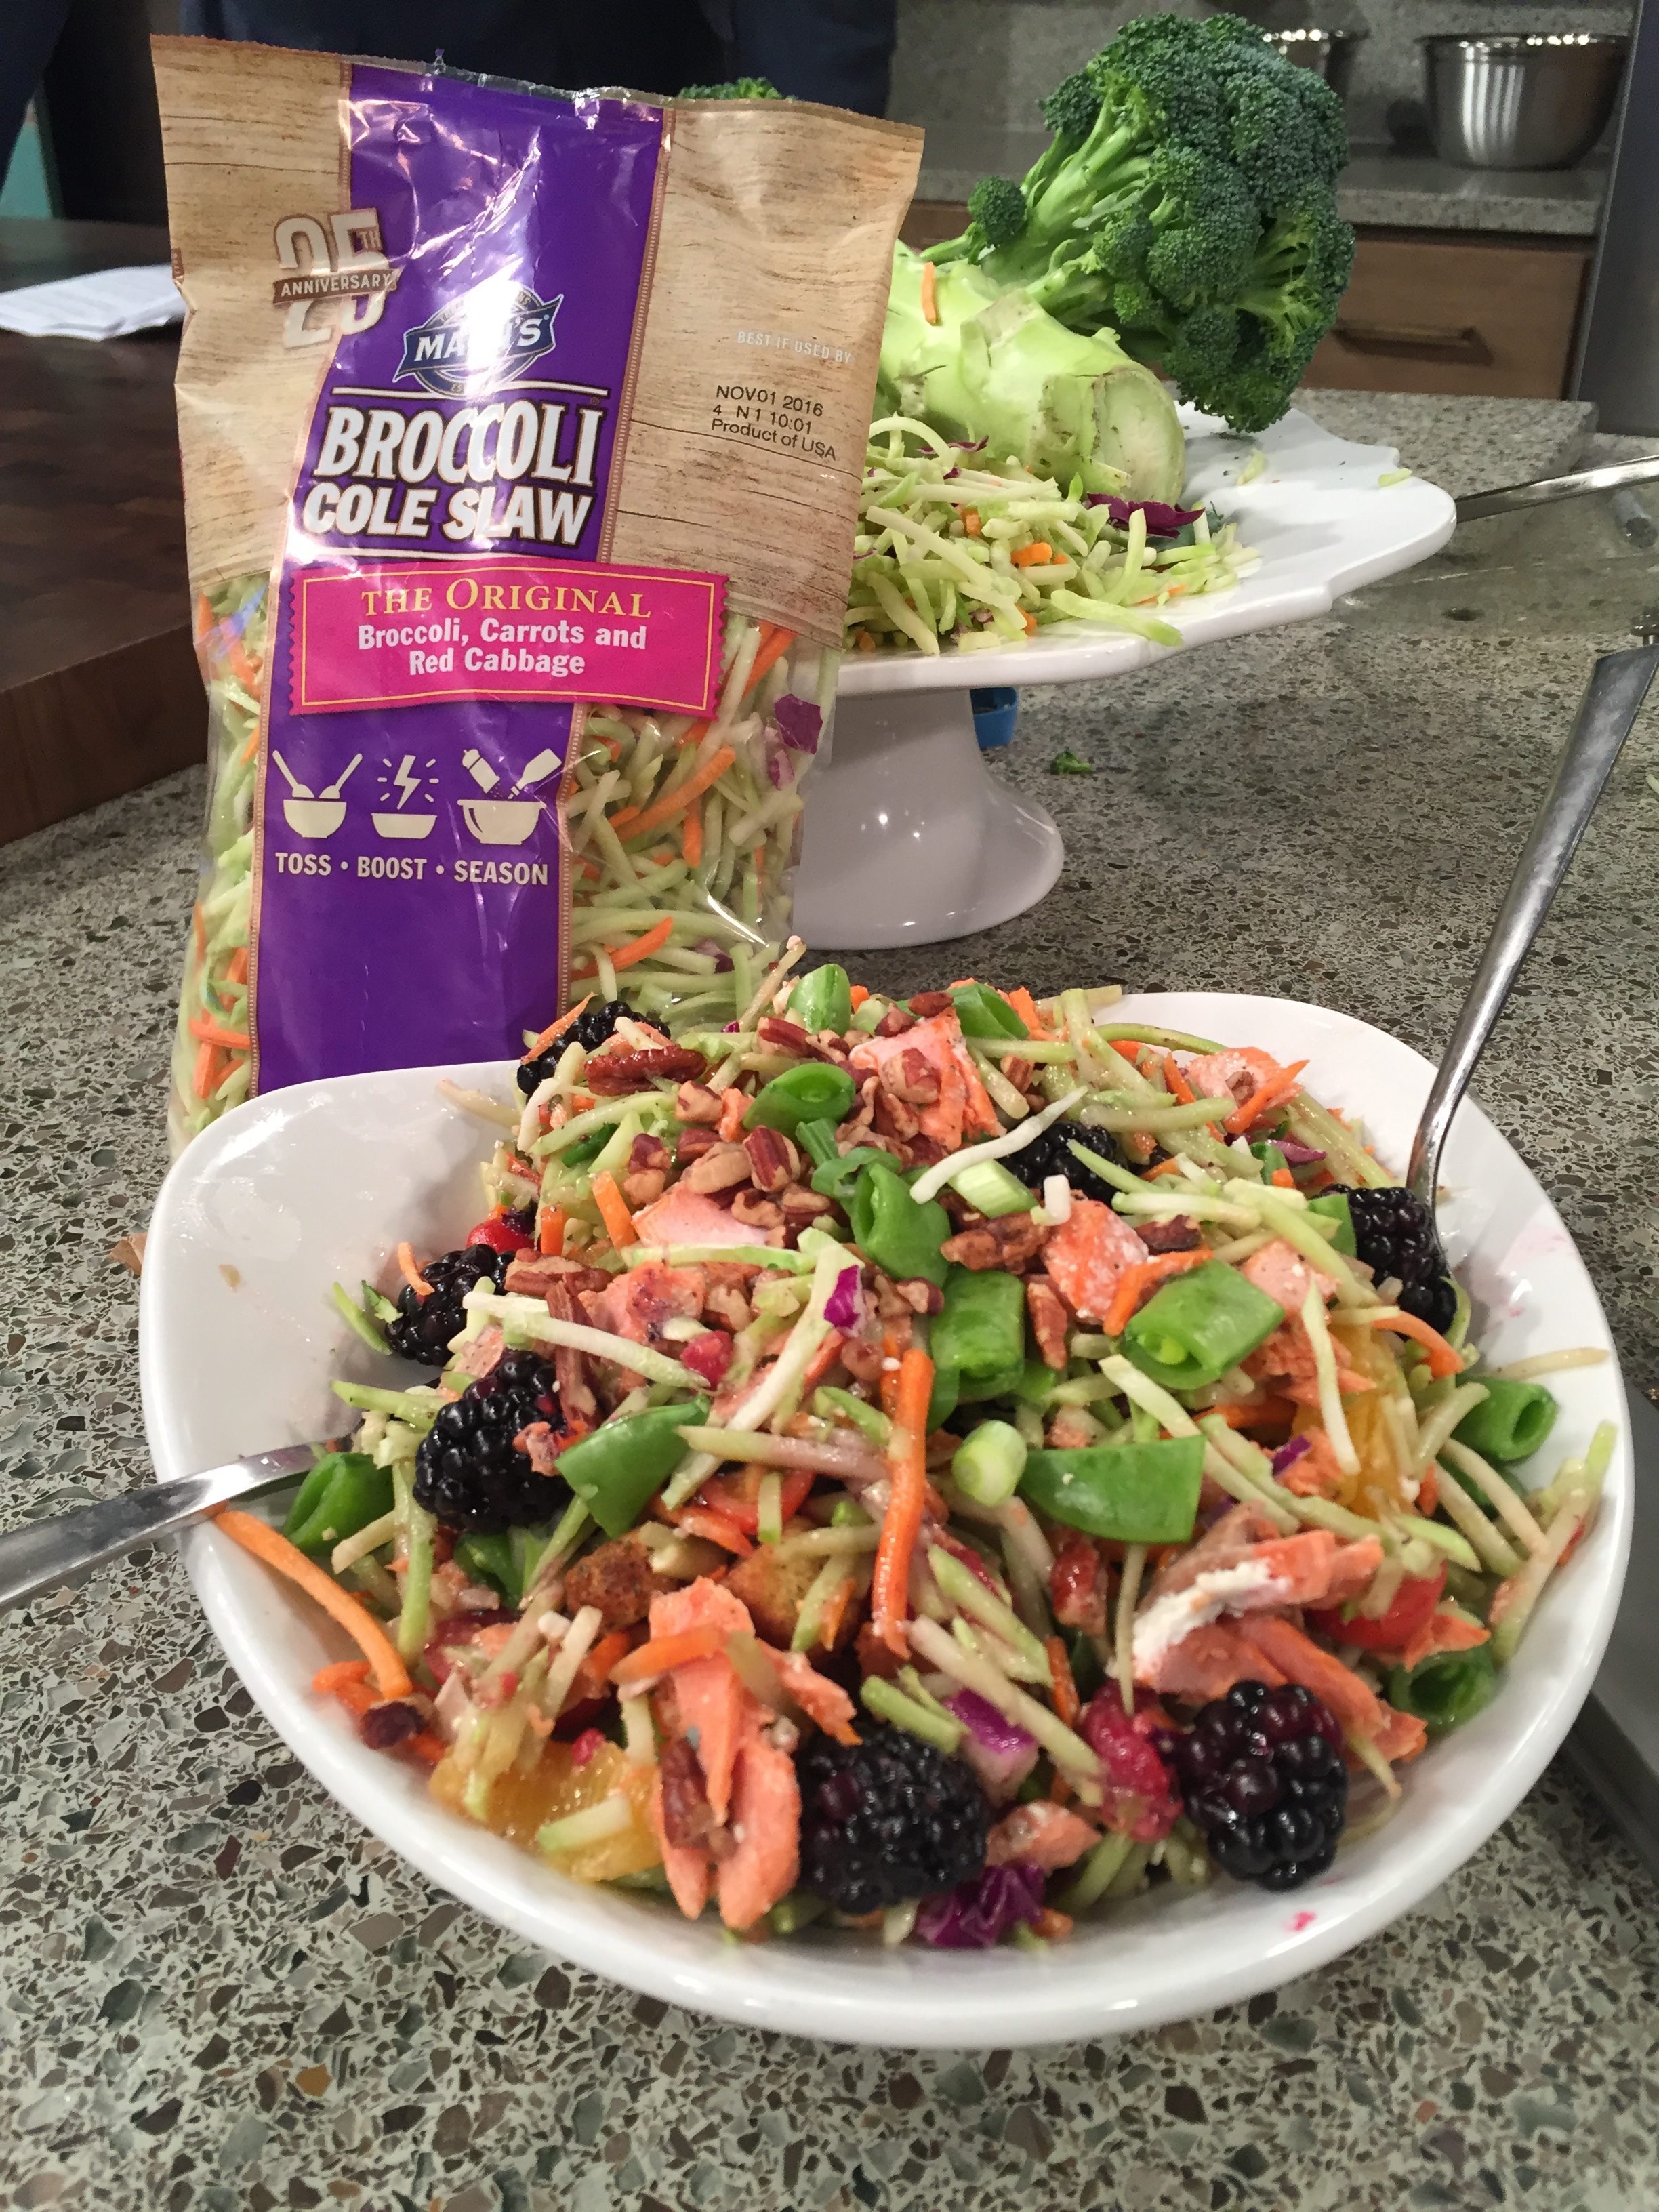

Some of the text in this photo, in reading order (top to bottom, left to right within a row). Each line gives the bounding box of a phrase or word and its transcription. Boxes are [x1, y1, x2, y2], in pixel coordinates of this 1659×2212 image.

[281, 272, 392, 297] ANNIVERSARY
[737, 331, 852, 364] BEST IF USED BY
[716, 385, 823, 417] NOV01 2016
[712, 405, 722, 416] 4
[771, 412, 811, 434] 10:01
[314, 400, 604, 487] BROCCOLI
[712, 418, 836, 462] Product of USA
[304, 484, 592, 545] COLE SLAW
[361, 588, 432, 617] THE
[358, 617, 647, 649] Broccoli, Carrots and
[409, 649, 586, 677] Red Cabbage
[276, 852, 549, 886] TOSS BOOST SEASON
